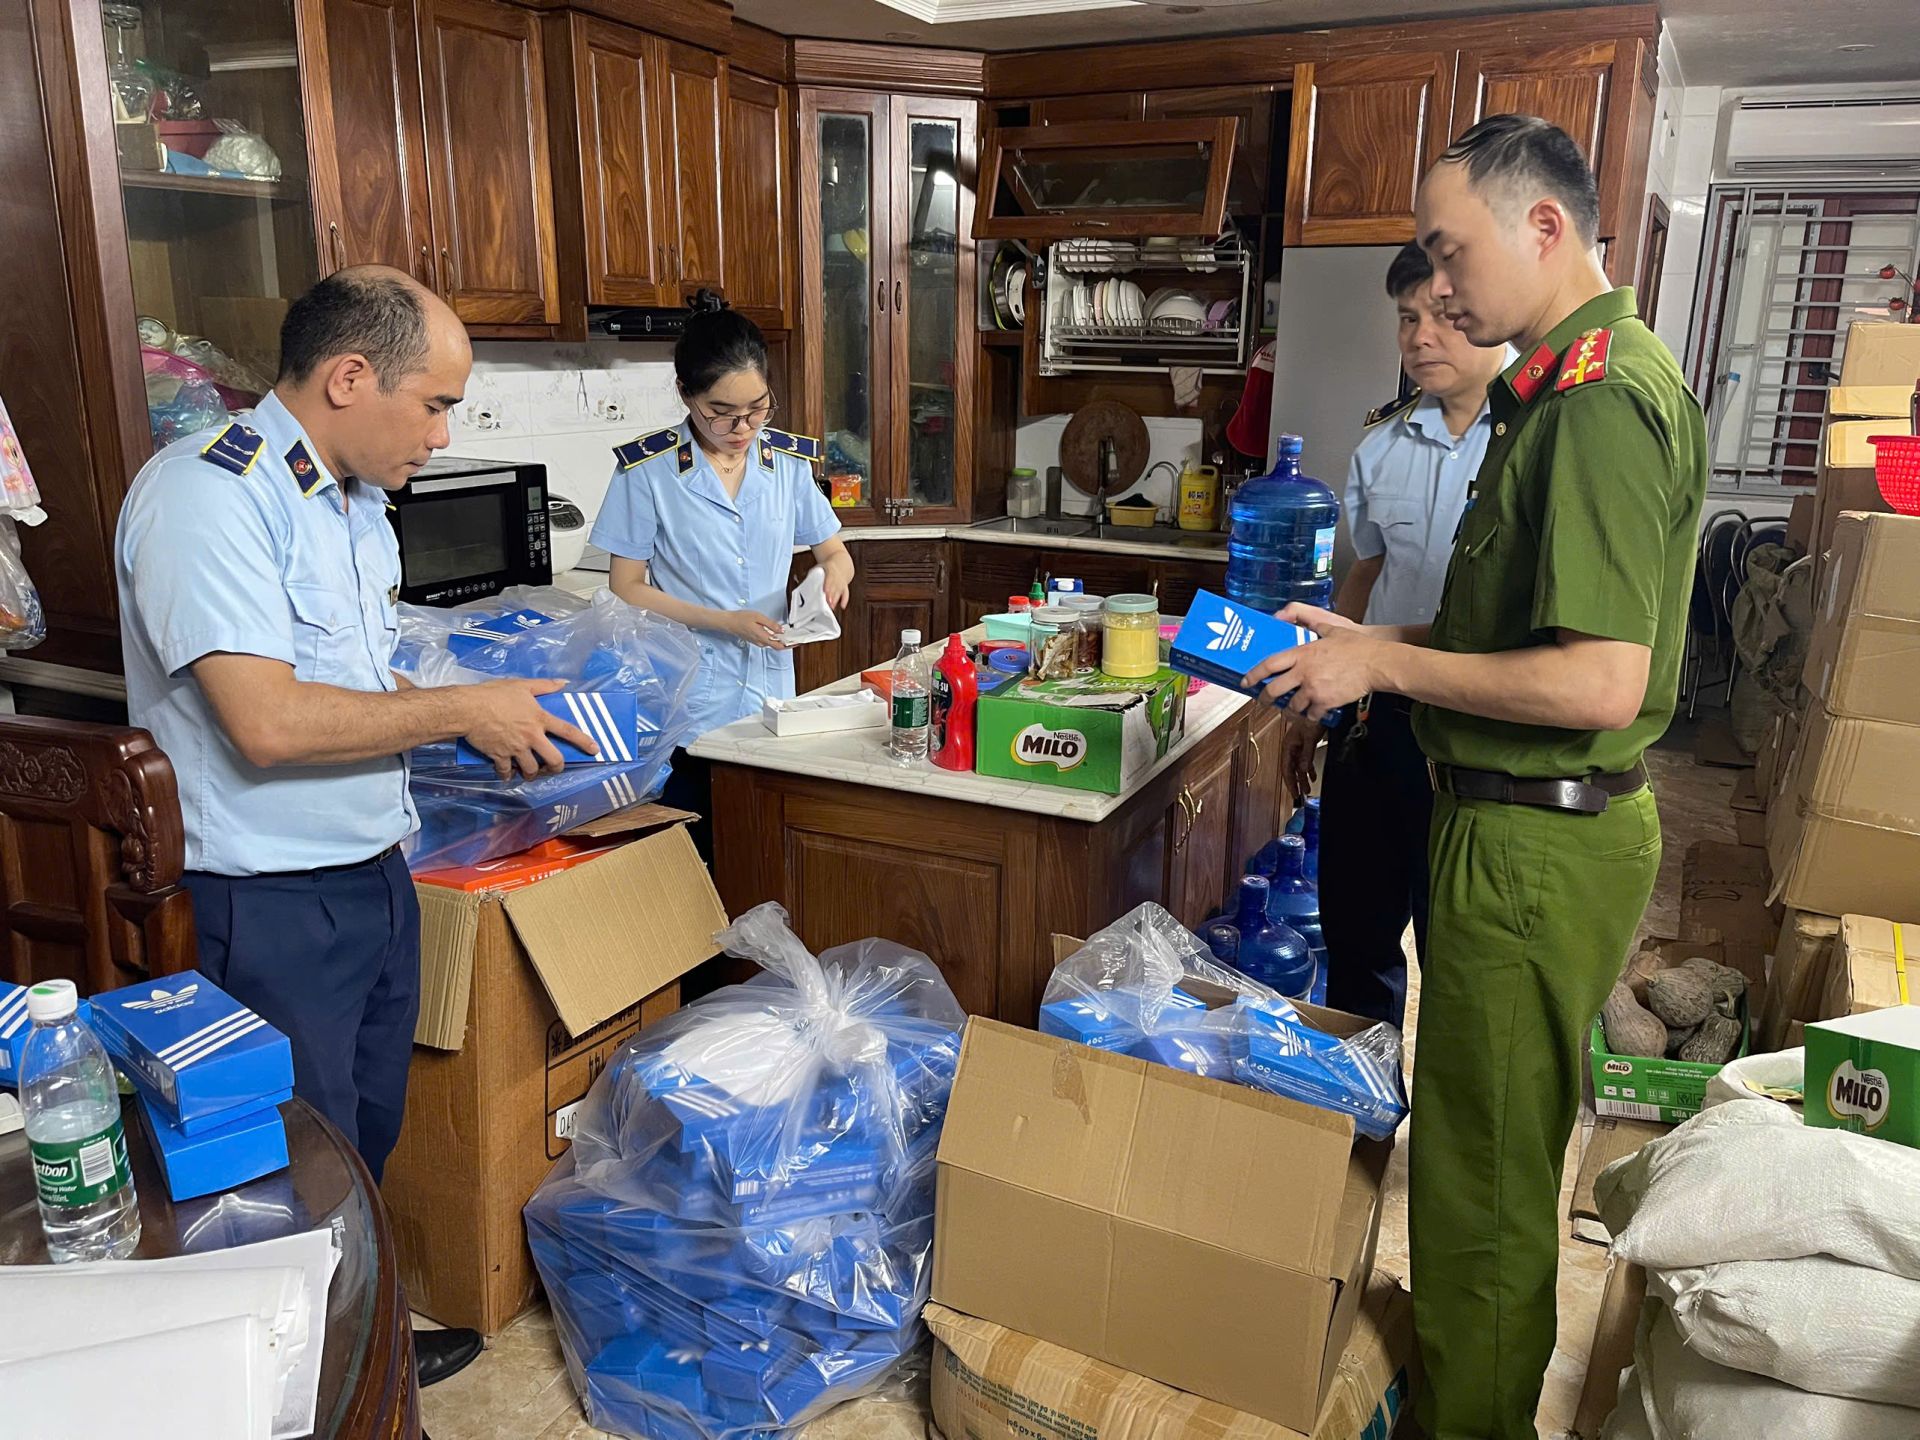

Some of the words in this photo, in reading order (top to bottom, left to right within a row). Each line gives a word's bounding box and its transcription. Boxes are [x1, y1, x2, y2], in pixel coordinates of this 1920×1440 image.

[1241, 627, 1255, 651] adidas
[1022, 735, 1078, 758] MILO
[154, 1000, 195, 1014] adidas
[1607, 1063, 1629, 1072] MILO
[1836, 1076, 1882, 1111] MILO
